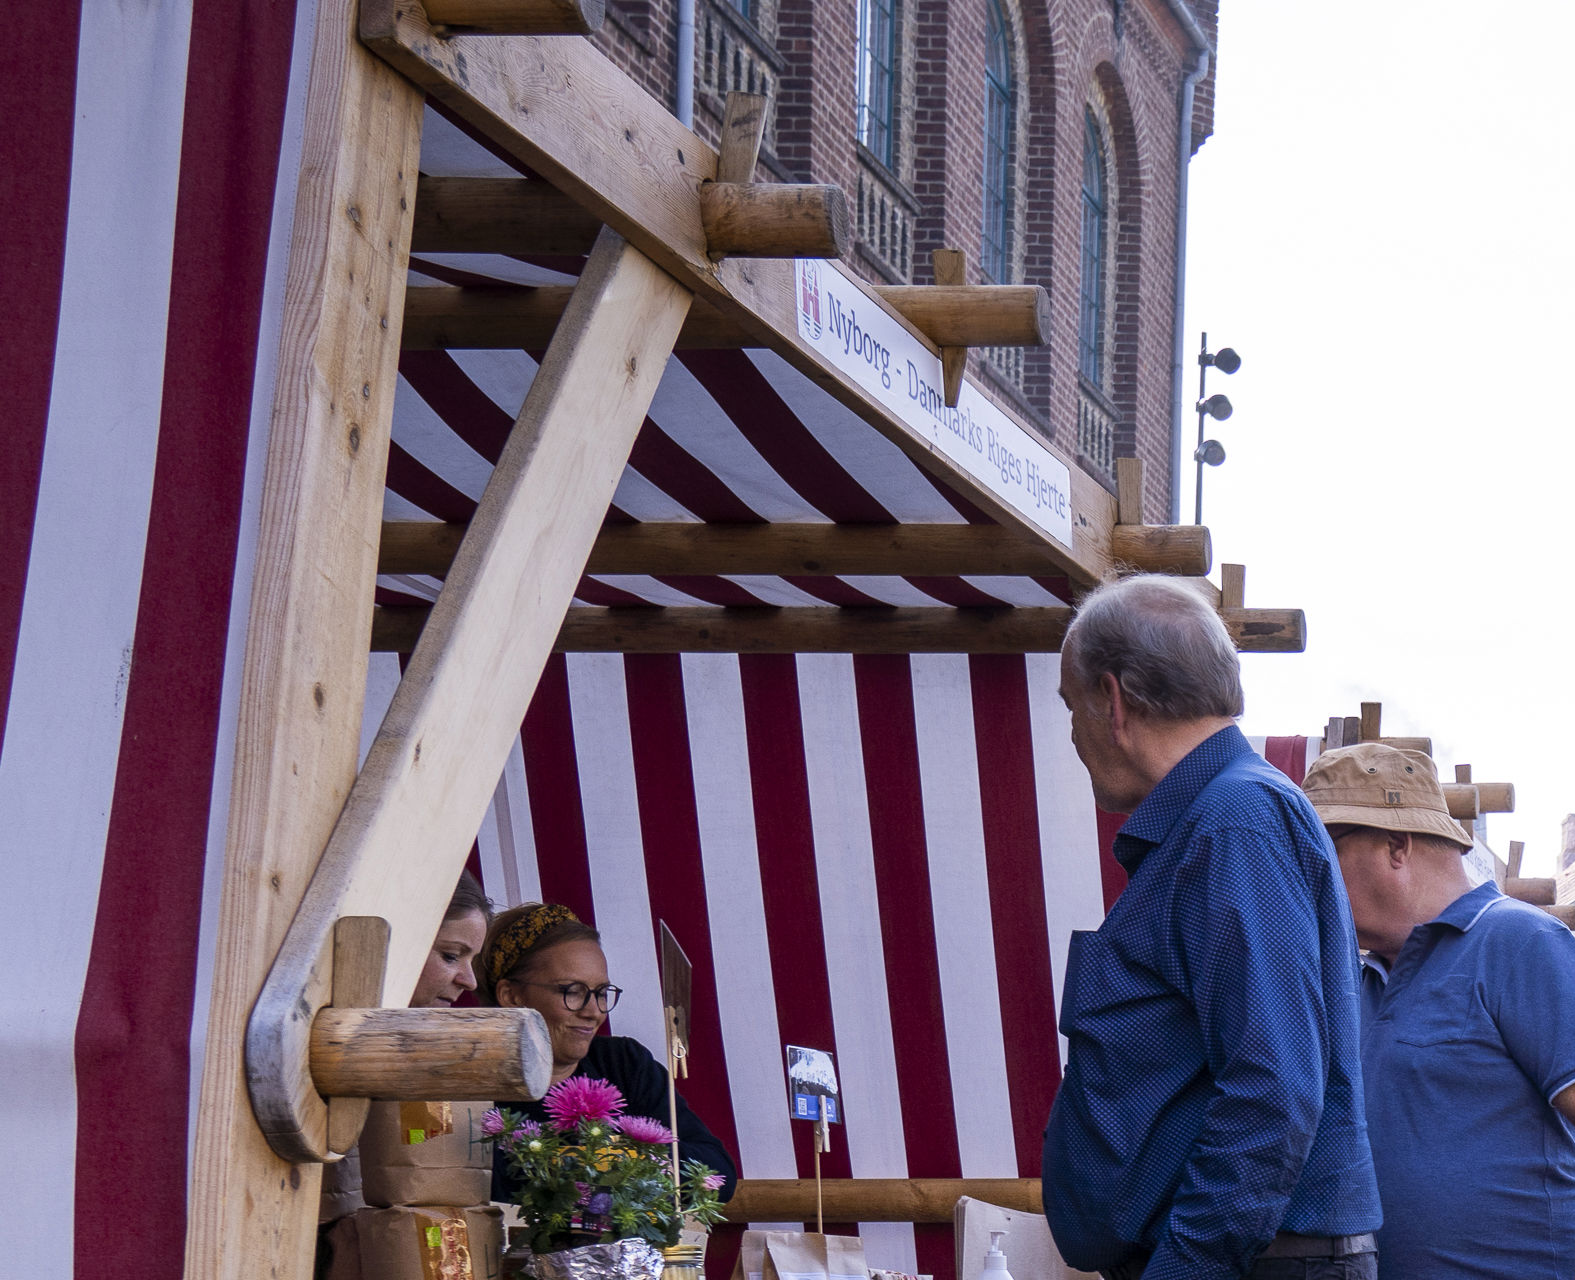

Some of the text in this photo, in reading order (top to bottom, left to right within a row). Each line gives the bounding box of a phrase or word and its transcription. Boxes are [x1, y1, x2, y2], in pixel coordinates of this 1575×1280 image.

[828, 291, 891, 390] Nyborg
[987, 426, 1022, 485] Riges
[1026, 458, 1066, 519] Hjerte
